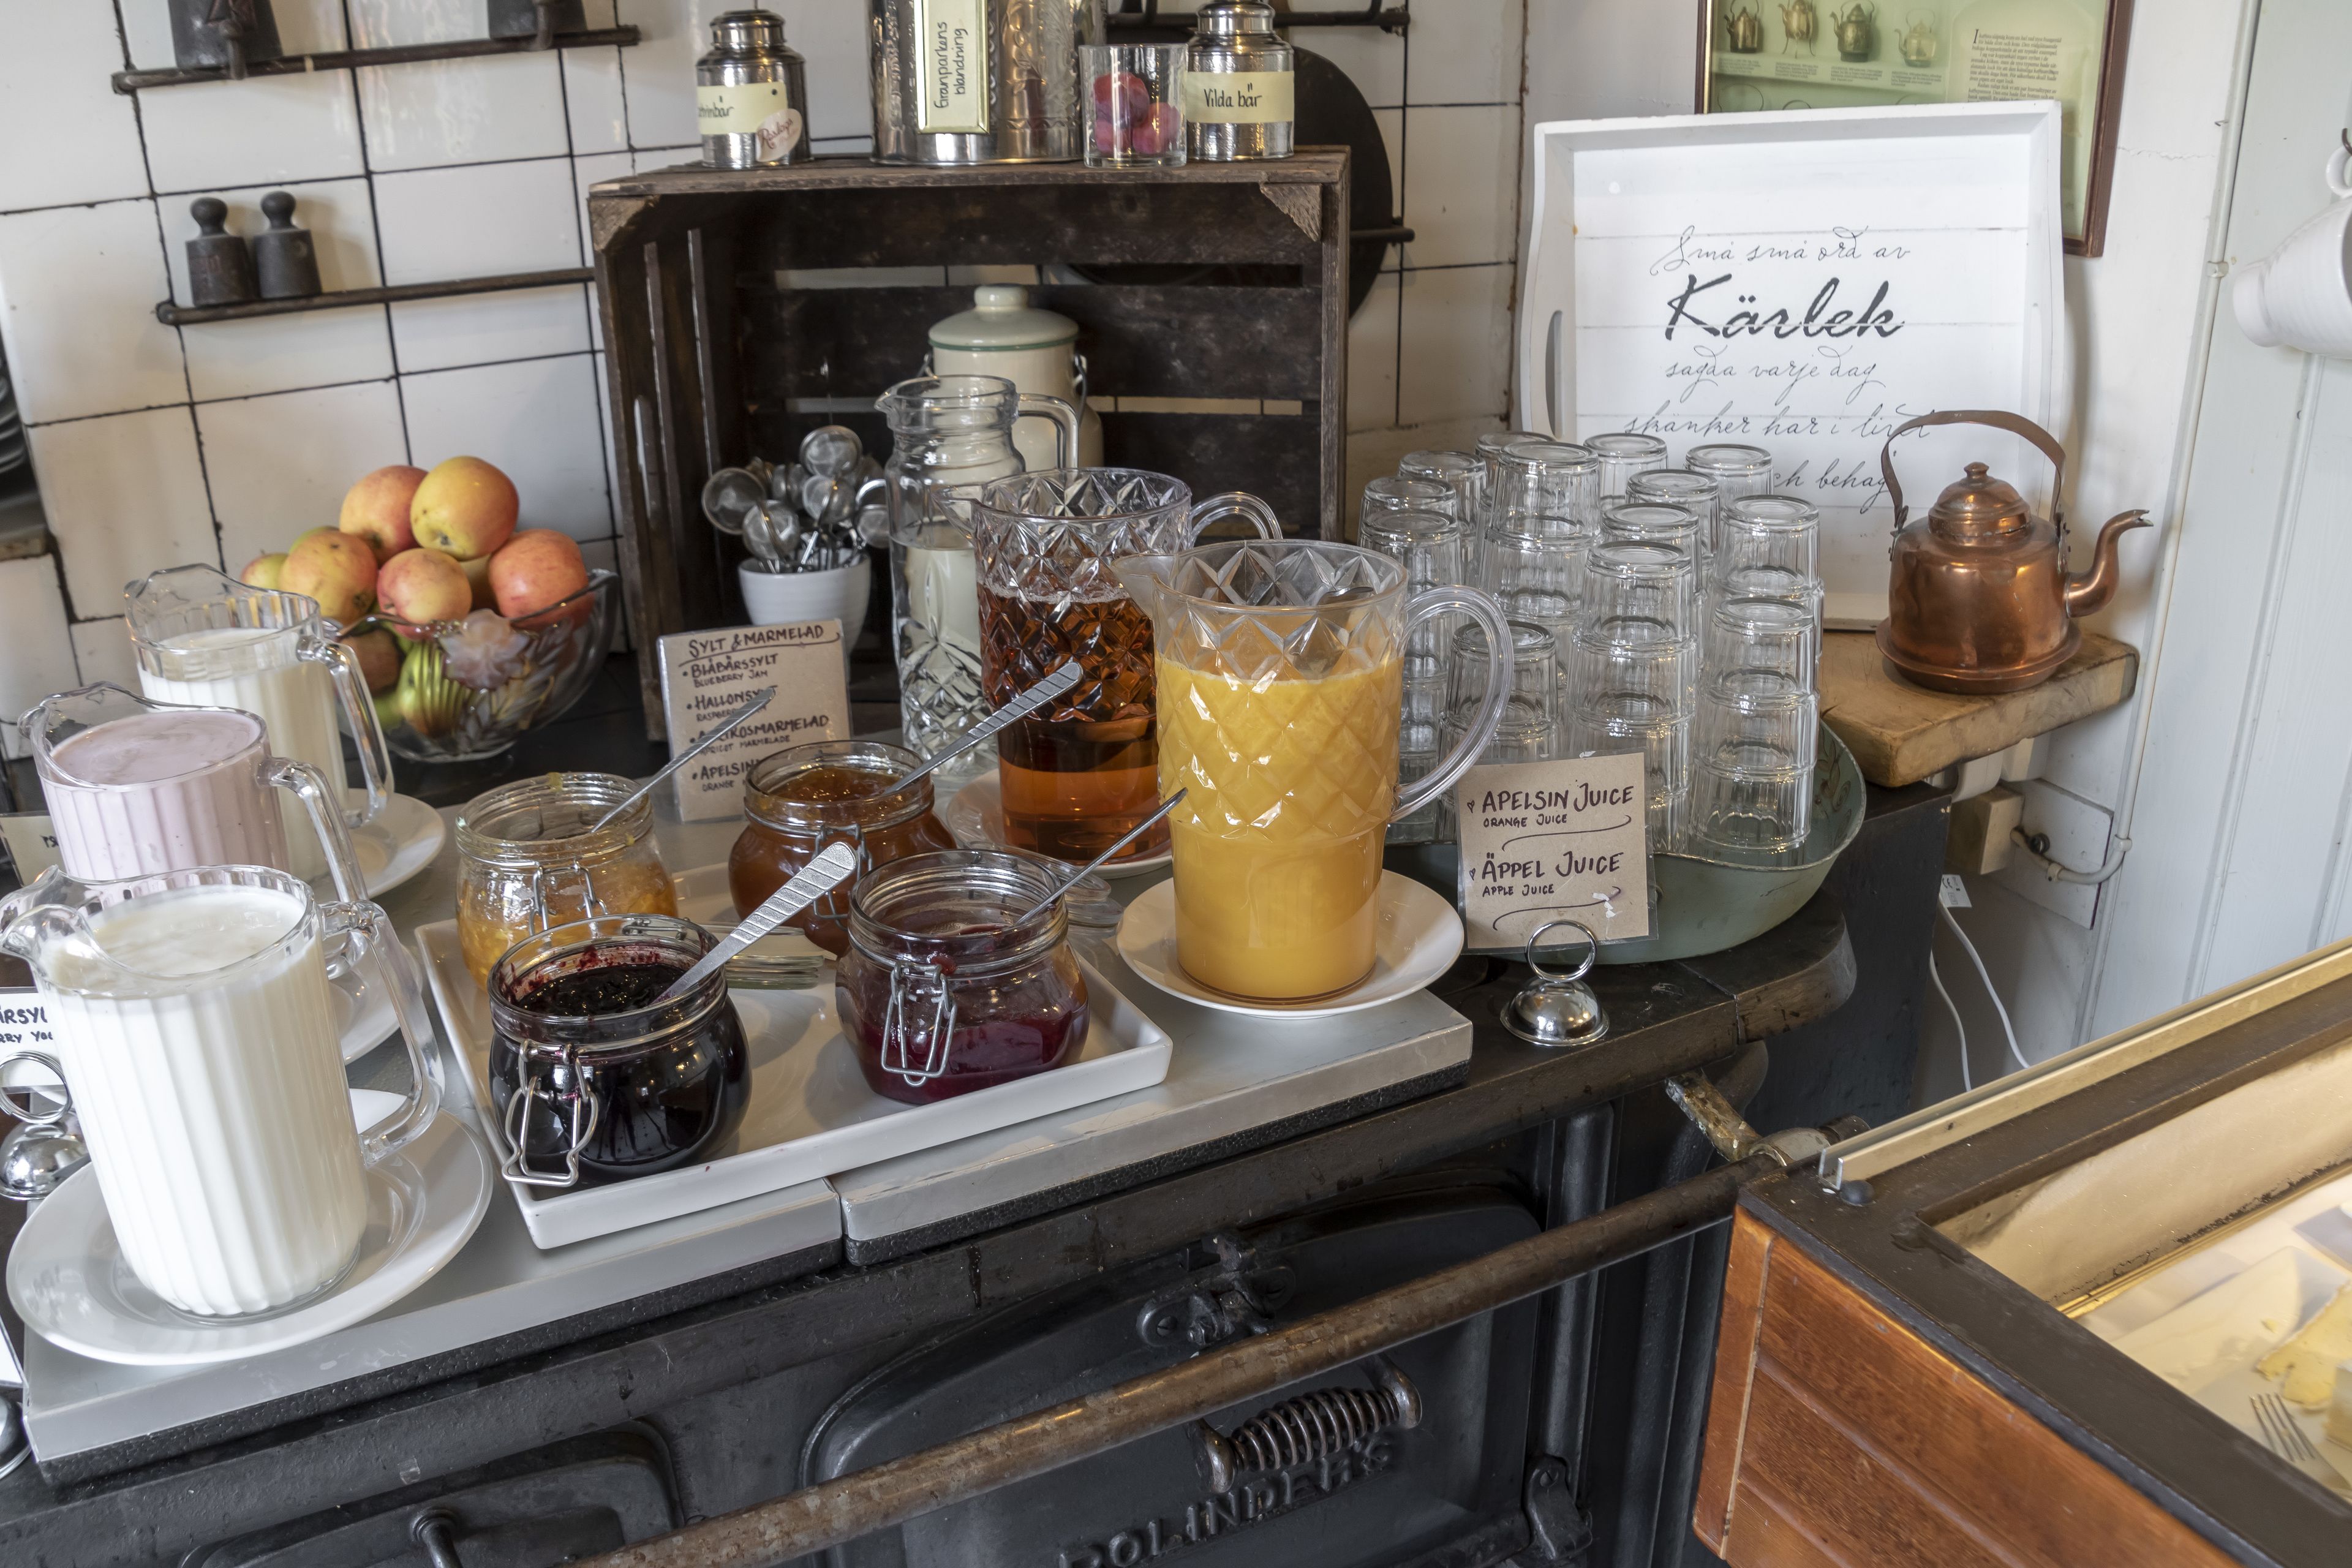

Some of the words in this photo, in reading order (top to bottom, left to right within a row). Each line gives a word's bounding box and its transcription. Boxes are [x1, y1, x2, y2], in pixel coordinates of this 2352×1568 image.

[952, 28, 968, 94] blandning
[1204, 88, 1234, 108] Vilda
[1237, 83, 1263, 108] bär
[1649, 225, 1736, 276] Små
[1747, 239, 1809, 261] små
[1817, 225, 1870, 261] ord
[1873, 246, 1911, 260] av
[1664, 273, 1905, 341] Kärlek
[1665, 344, 1737, 404] sagda
[1748, 353, 1820, 406] varje
[1817, 344, 1886, 405] dag
[1624, 399, 1751, 438] skänker
[1762, 405, 1820, 436] har
[1830, 417, 1842, 435] i
[1774, 459, 1809, 488] ch
[688, 638, 726, 658] SYLT
[744, 625, 824, 647] MARMELAD
[693, 673, 744, 688] BLUEBERRY
[748, 669, 768, 679] JAM
[701, 780, 735, 792] ORANGE
[1482, 790, 1569, 813] APELSIN
[1573, 782, 1634, 813] JUICE
[1483, 816, 1528, 828] ORANGE
[1536, 813, 1567, 825] JUICE
[1481, 852, 1545, 883] ÄPPEL
[1555, 850, 1624, 878] JUICE
[1482, 885, 1514, 897] APPLE
[1521, 883, 1555, 896] JUICE
